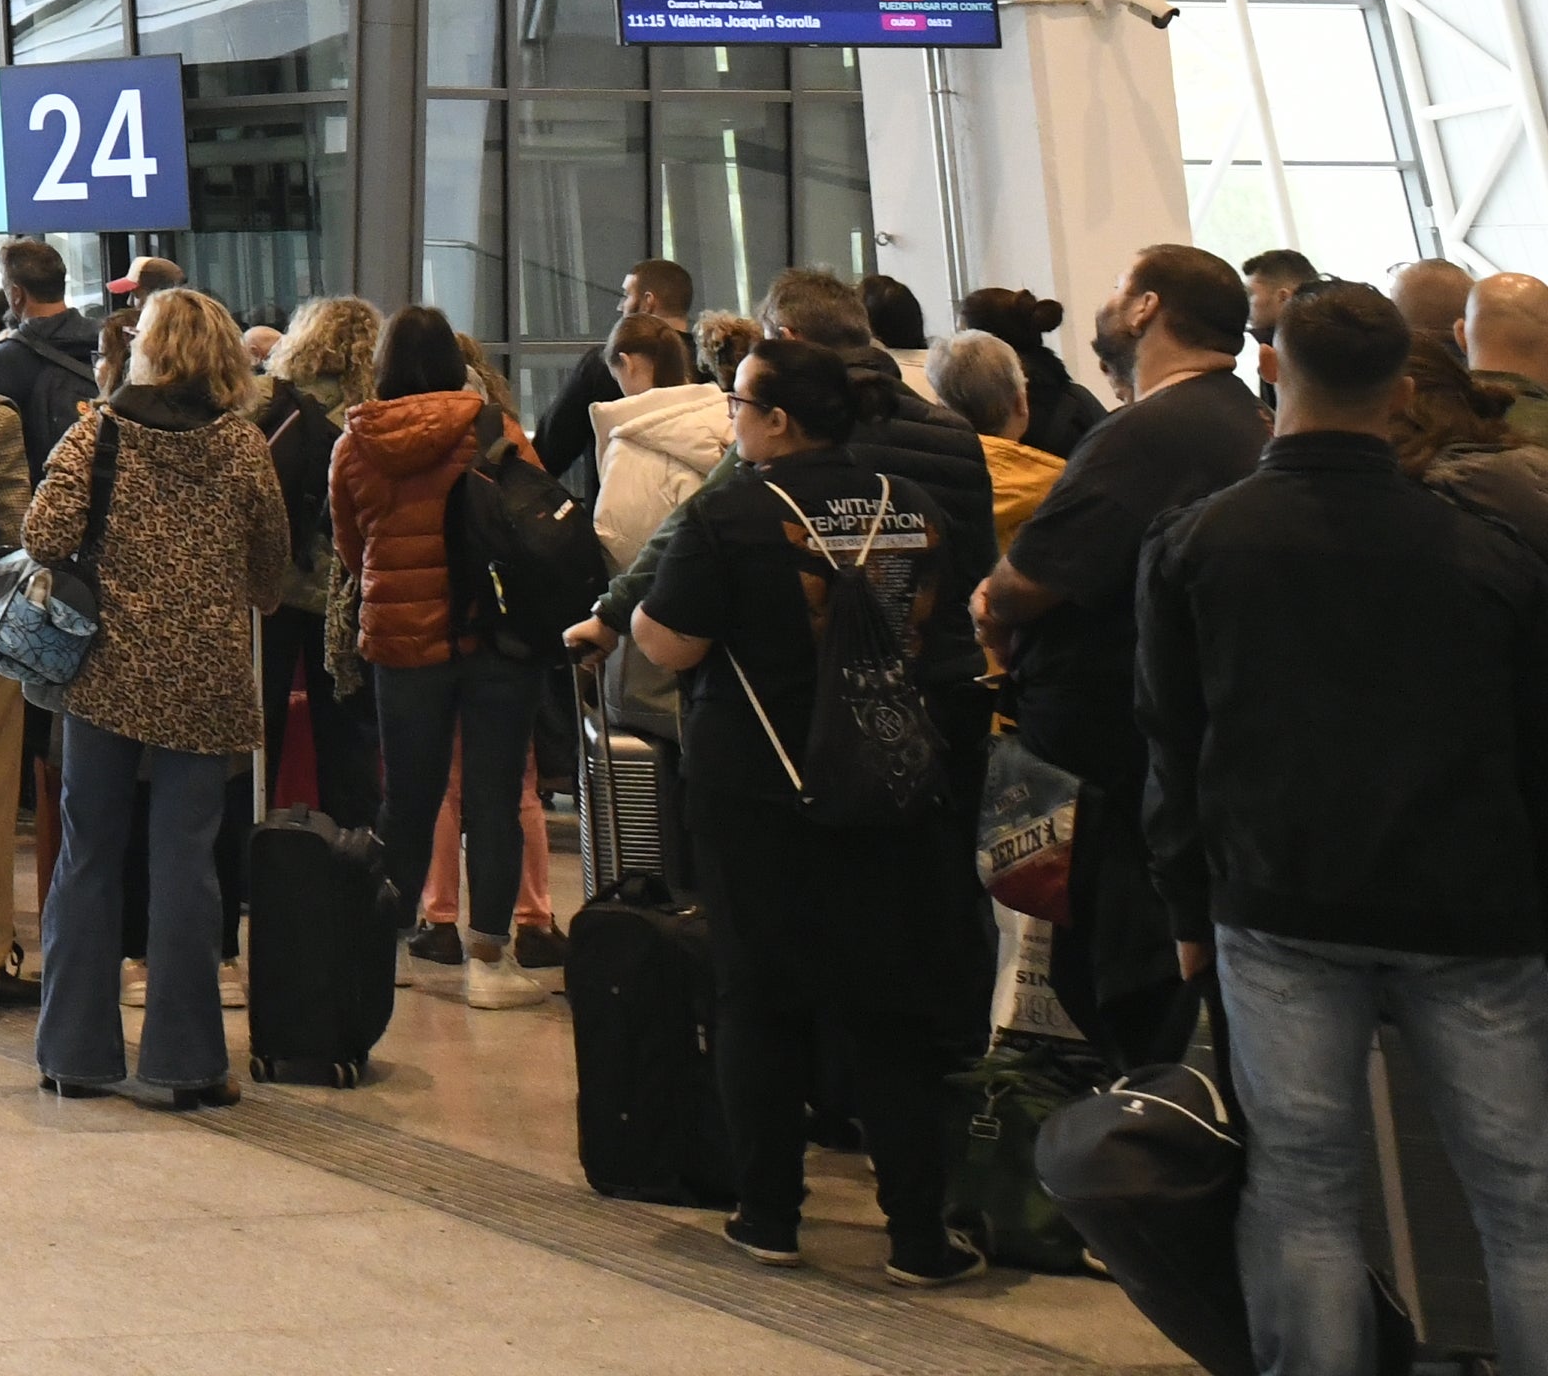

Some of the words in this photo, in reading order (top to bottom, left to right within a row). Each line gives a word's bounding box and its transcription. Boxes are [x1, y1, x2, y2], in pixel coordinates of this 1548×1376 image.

[878, 1, 912, 10] PUEDEN
[913, 2, 940, 10] PASAR
[941, 2, 958, 10] POR
[627, 14, 665, 27] 11:15
[668, 14, 723, 27] València
[723, 14, 774, 29] Joaquín
[775, 15, 820, 27] Sorolla
[29, 88, 158, 202] 24
[826, 498, 896, 516] WITHN
